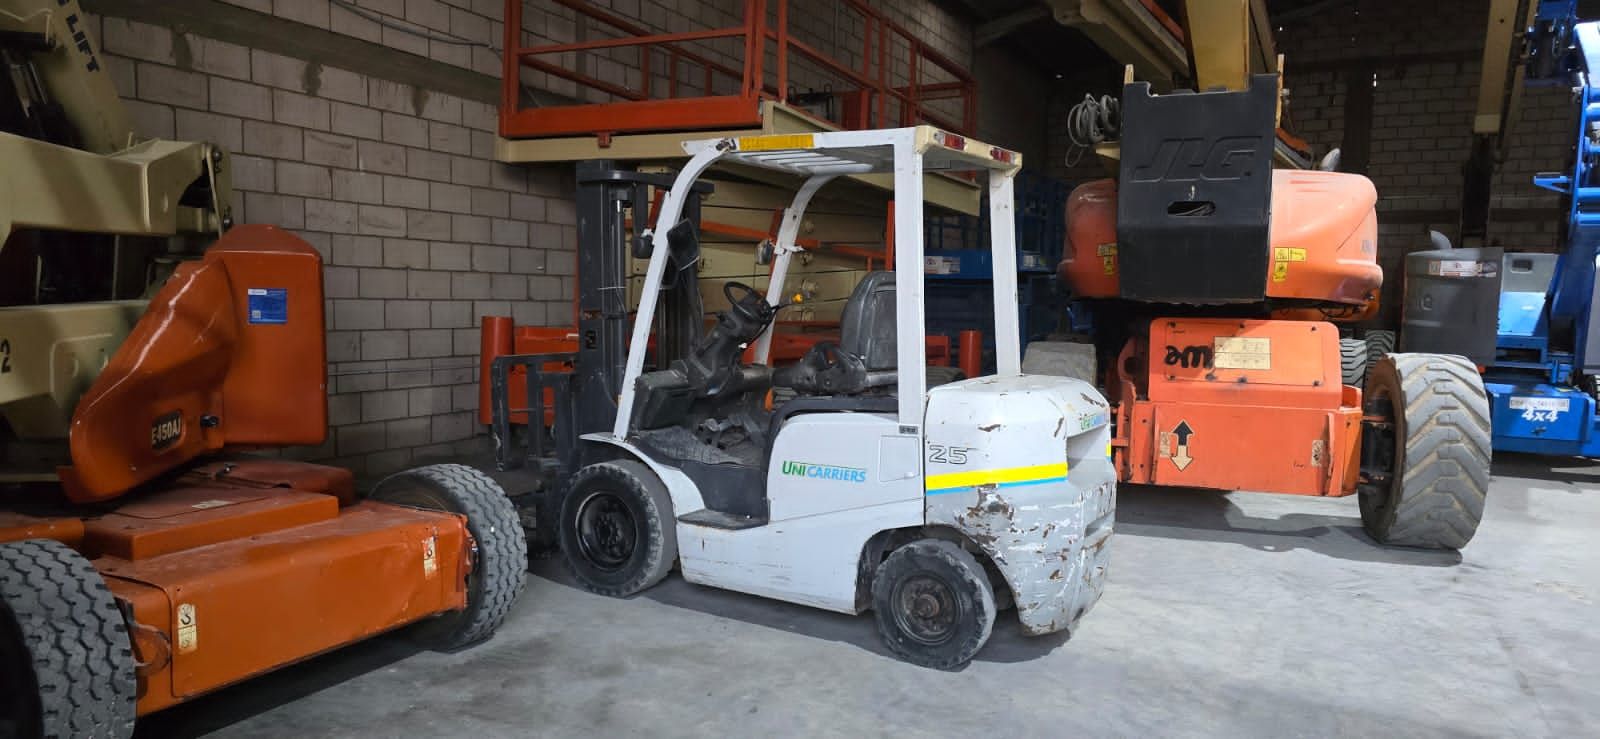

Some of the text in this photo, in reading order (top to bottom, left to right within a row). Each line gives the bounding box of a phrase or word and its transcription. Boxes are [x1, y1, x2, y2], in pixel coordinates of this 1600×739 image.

[65, 14, 100, 72] LIFT
[1128, 136, 1263, 182] JLG
[1521, 408, 1559, 422] 4x4
[929, 444, 968, 465] 25
